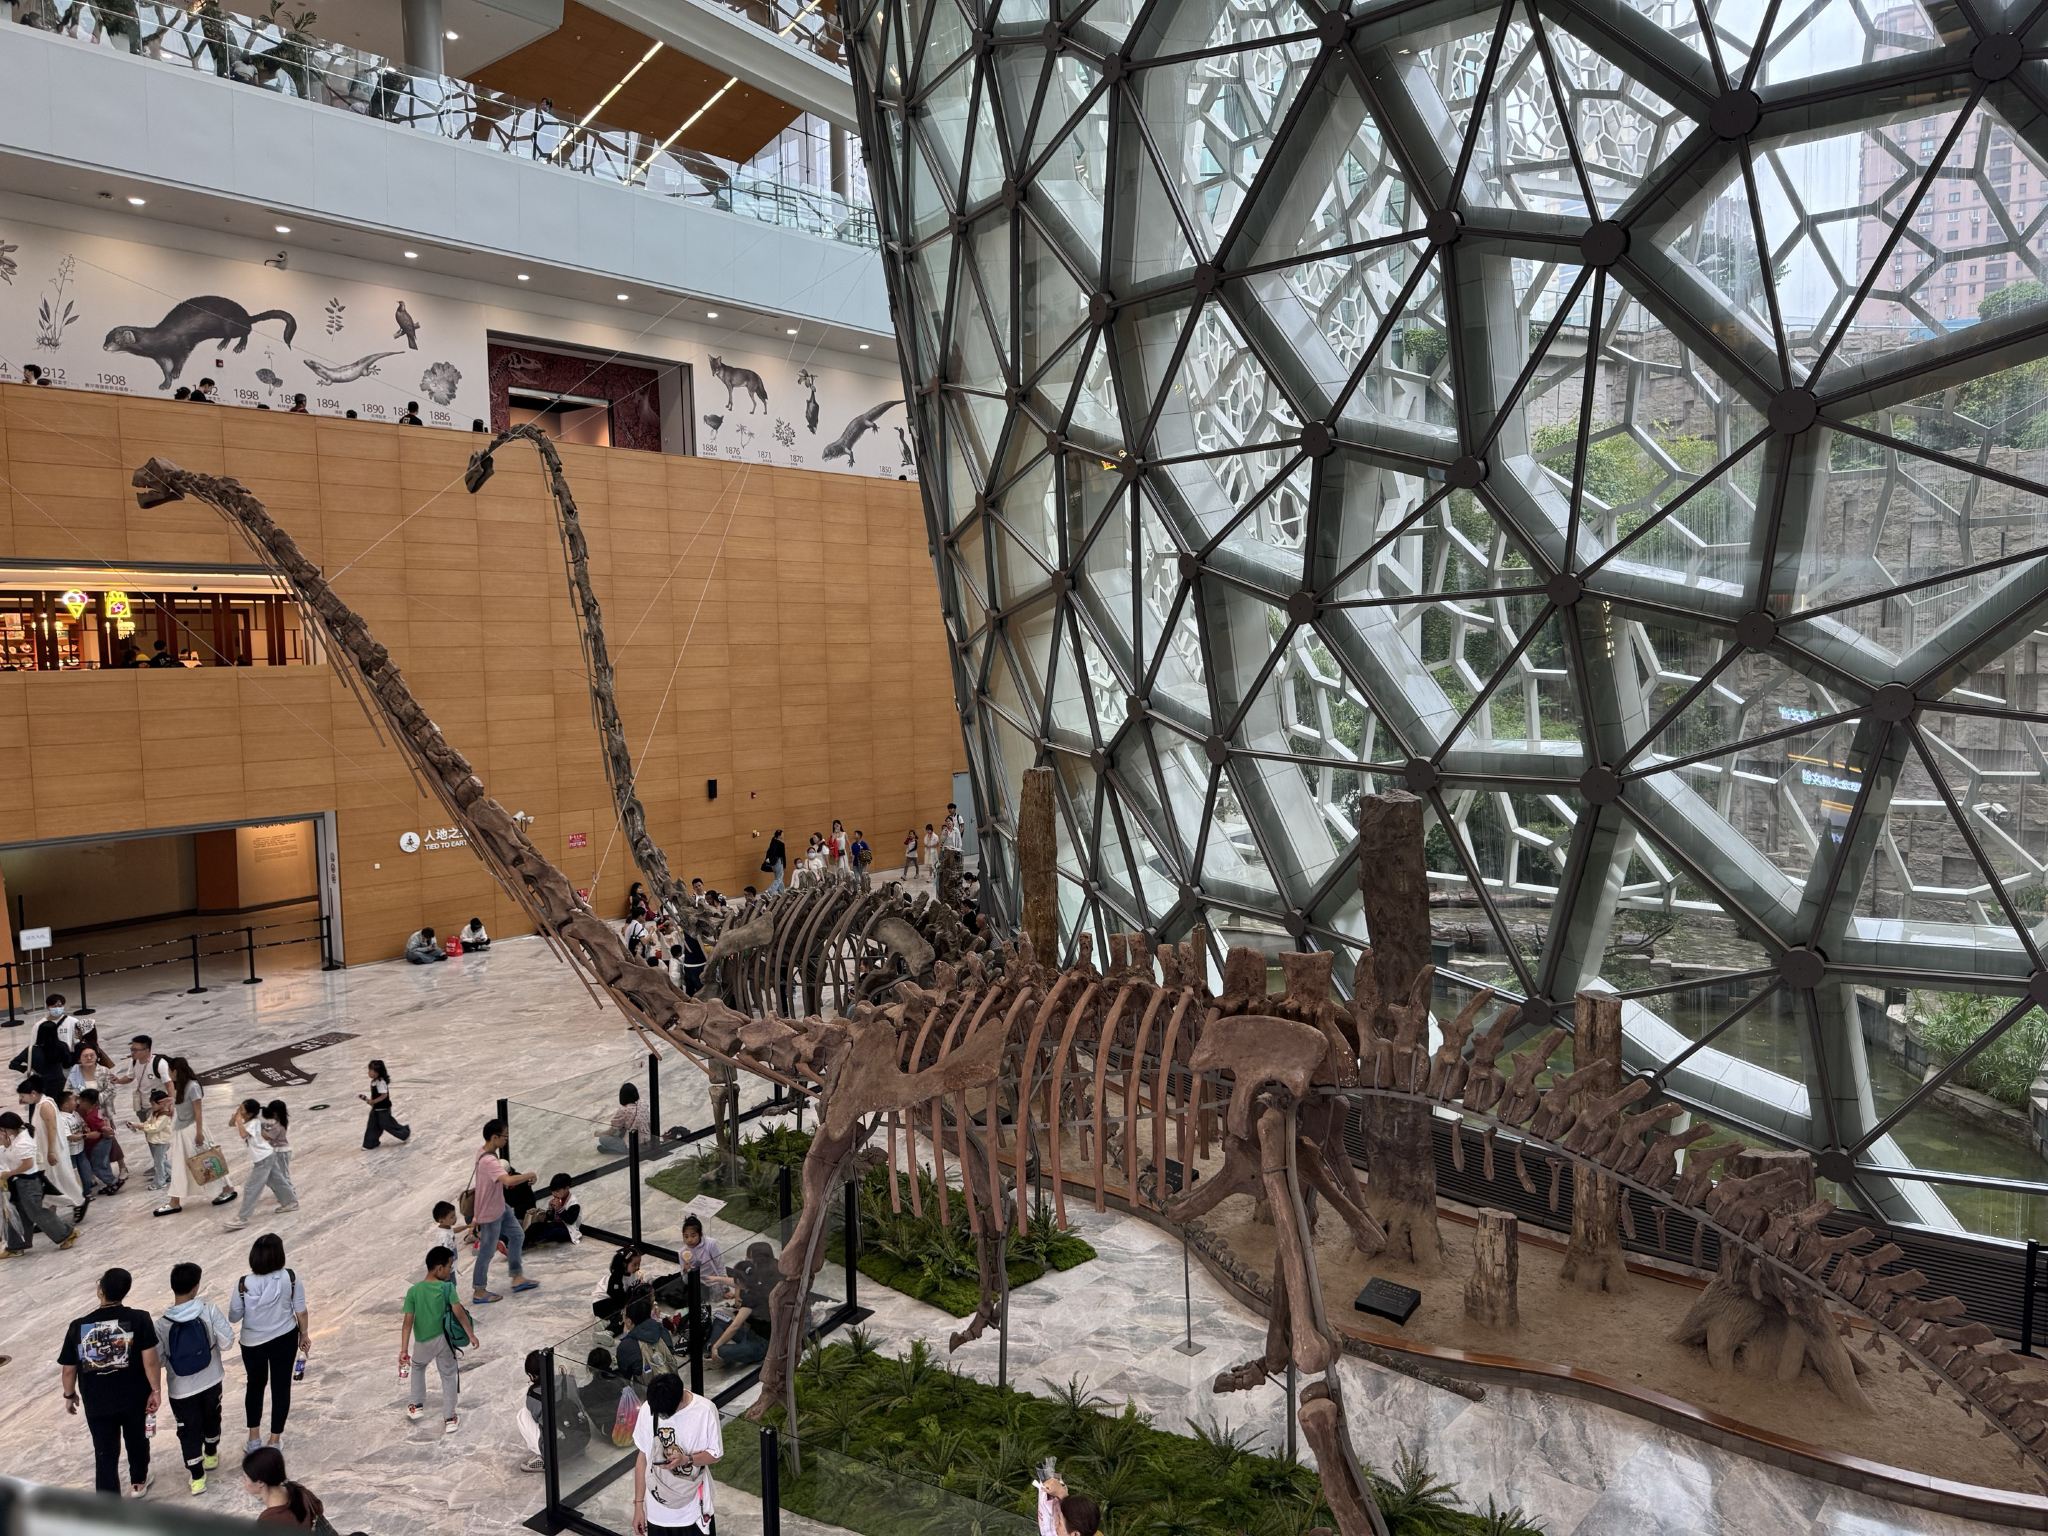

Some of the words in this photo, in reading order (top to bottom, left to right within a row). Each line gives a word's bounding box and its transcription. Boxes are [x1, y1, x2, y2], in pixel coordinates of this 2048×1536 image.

[41, 366, 66, 380] 912
[97, 373, 126, 386] 1908
[234, 388, 260, 400] 1898
[280, 394, 296, 405] 189
[317, 398, 340, 409] 1894
[362, 403, 385, 414] 1890
[393, 406, 409, 416] 188
[429, 410, 451, 421] 1886
[702, 443, 718, 452] 1884
[725, 446, 741, 455] 1876
[757, 450, 772, 459] 1871
[789, 454, 804, 463] 1870
[424, 827, 463, 842] 人地之
[451, 839, 467, 847] EART
